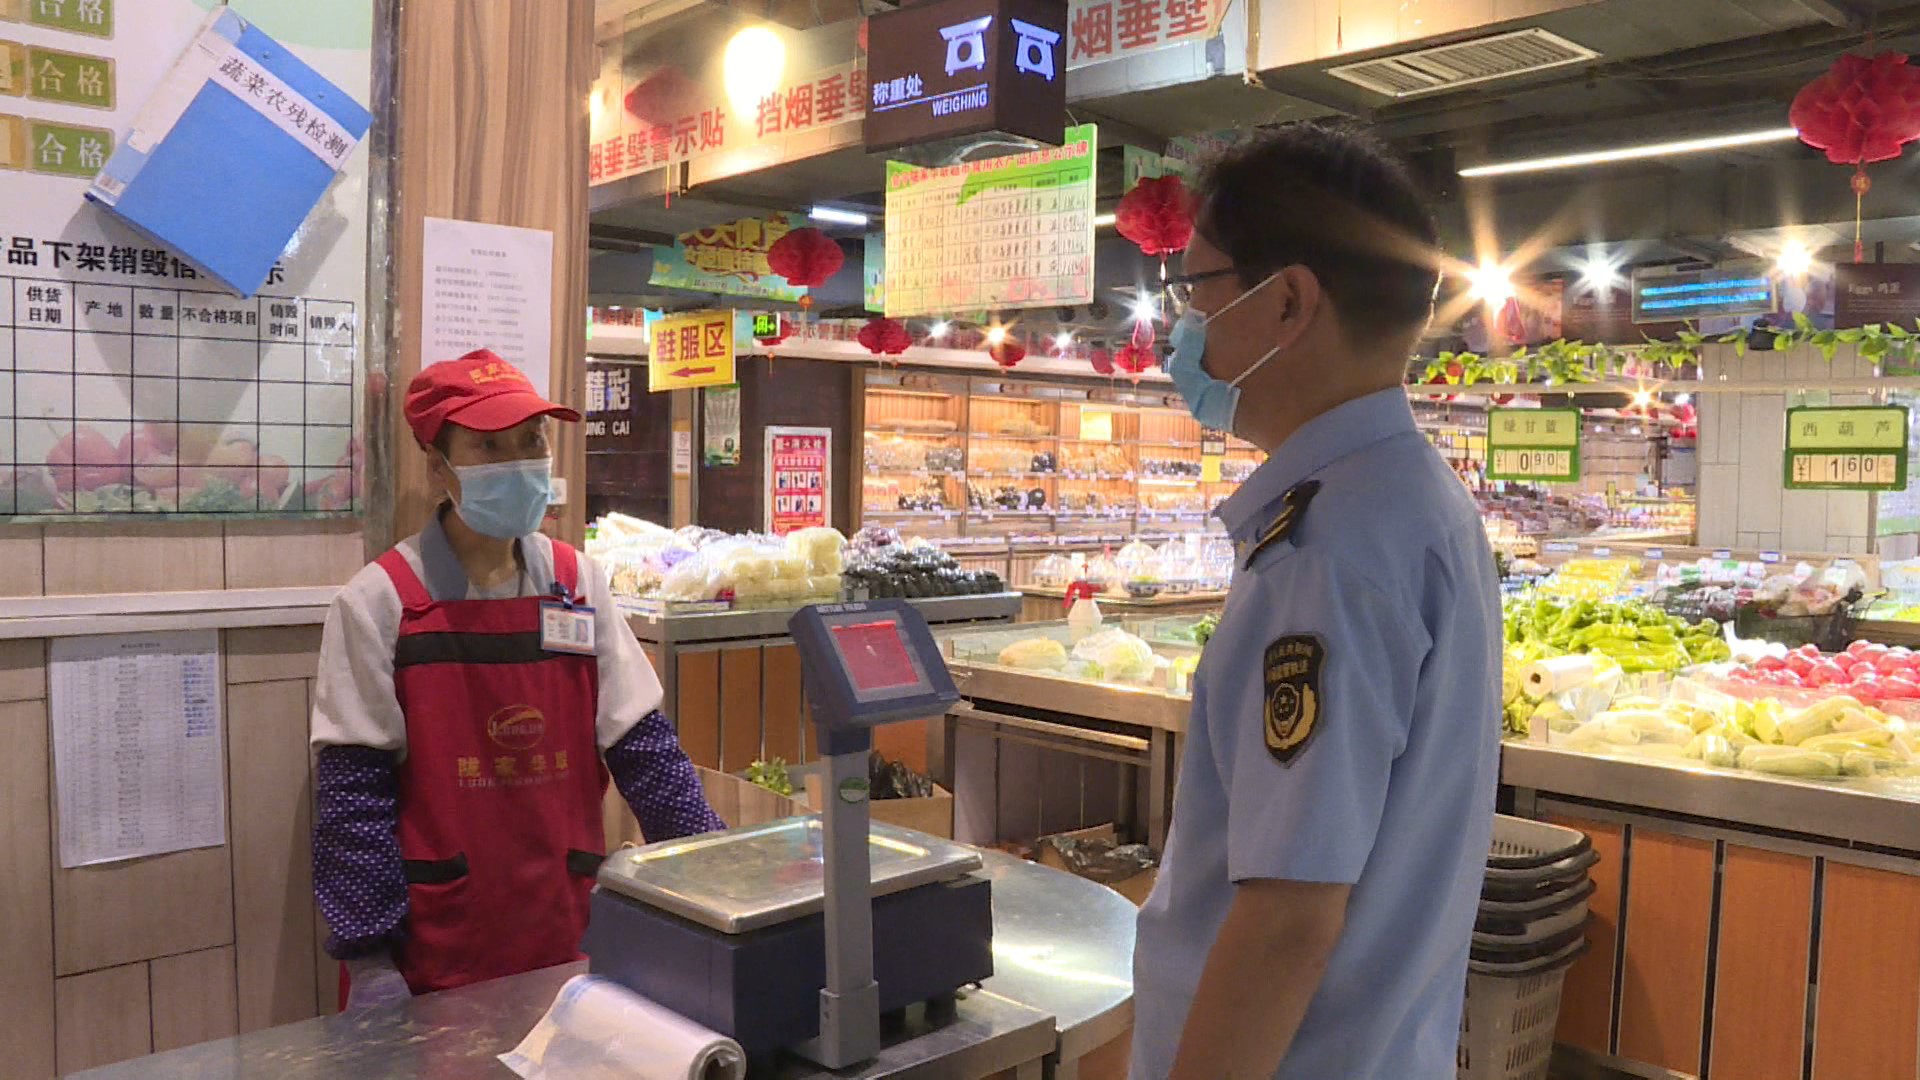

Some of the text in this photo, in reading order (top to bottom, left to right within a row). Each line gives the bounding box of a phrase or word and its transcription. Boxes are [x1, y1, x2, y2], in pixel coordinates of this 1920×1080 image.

[40, 59, 104, 97] 合格
[873, 72, 923, 106] 称重处
[218, 55, 350, 160] 蔬菜农残检测
[932, 90, 987, 117] WEIGHING
[40, 133, 104, 169] 合格
[26, 286, 64, 304] 供货
[28, 307, 62, 324] 日期
[84, 300, 124, 319] 产地
[138, 304, 175, 321] 数量
[182, 307, 256, 326] 不合格项目
[270, 303, 298, 319] 销毁
[269, 323, 298, 337] 时间
[656, 320, 726, 363] 鞋服区
[612, 420, 630, 435] CAI
